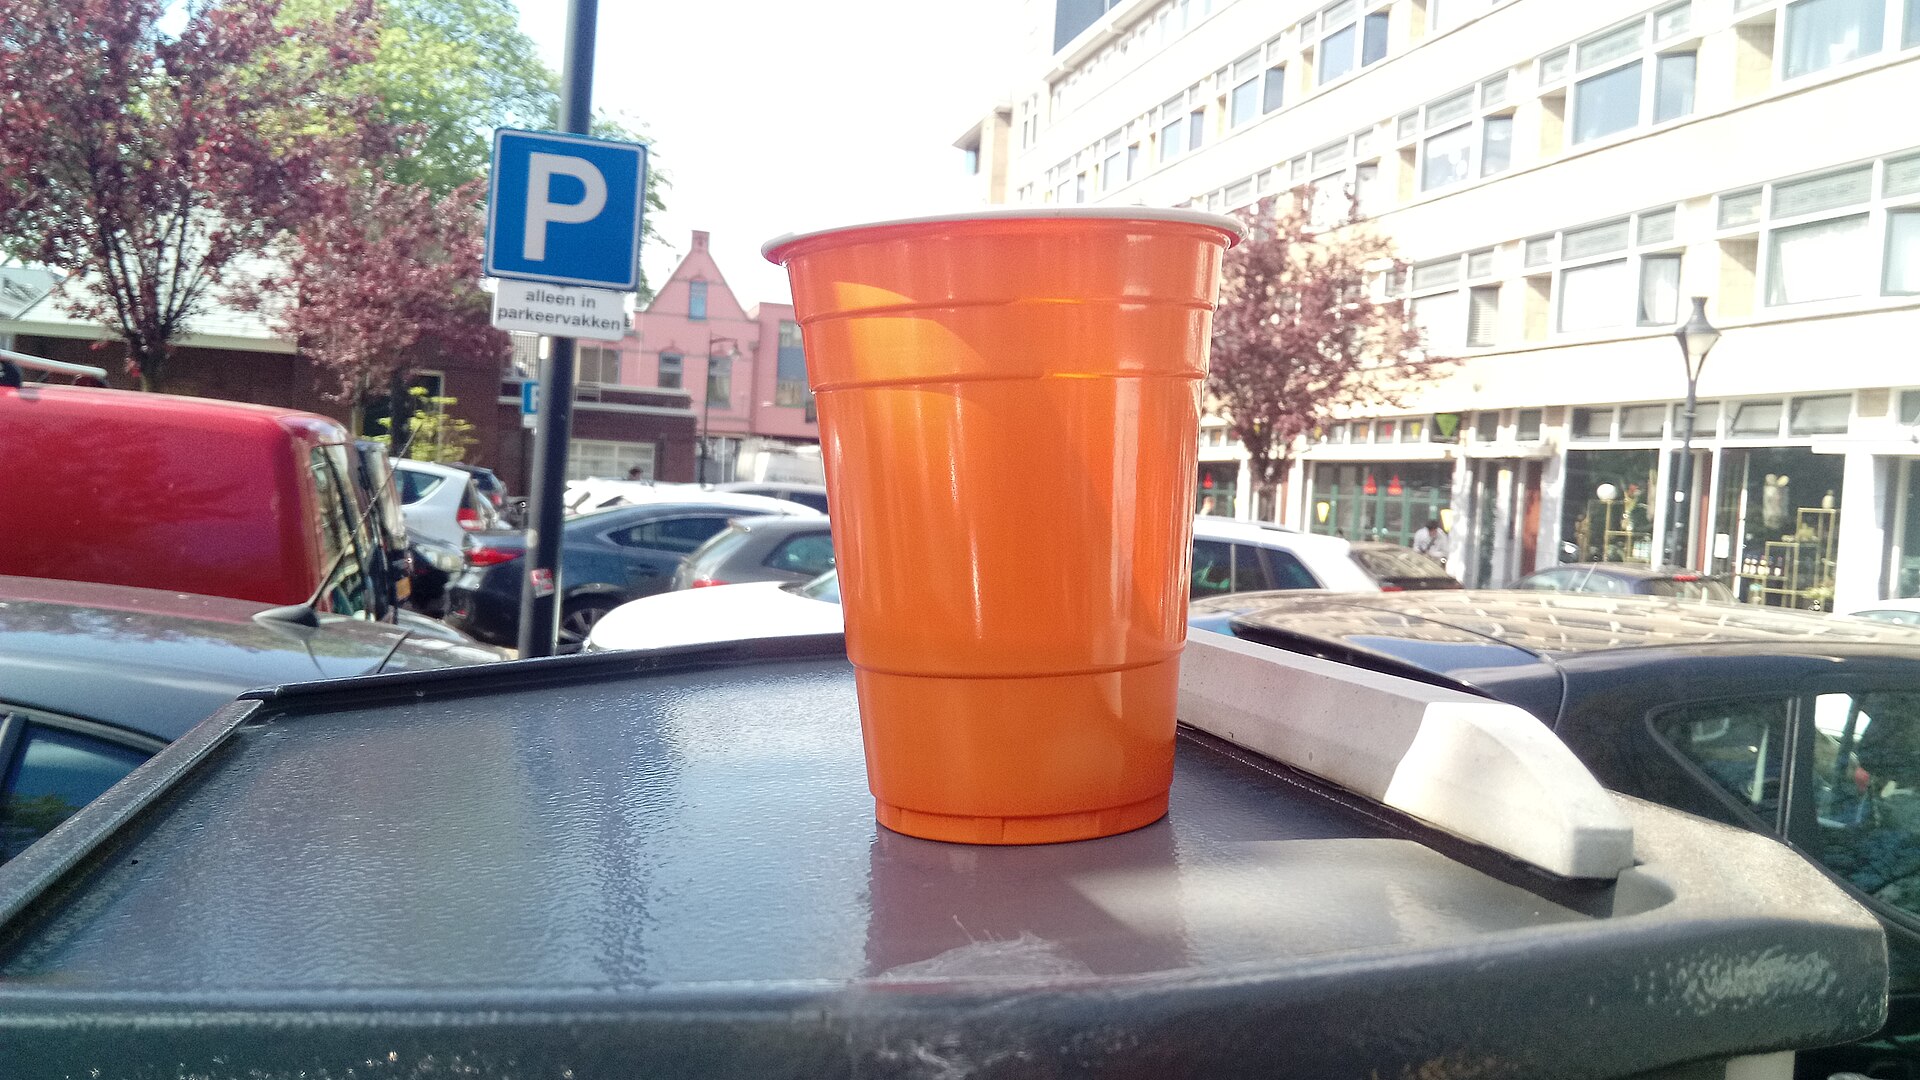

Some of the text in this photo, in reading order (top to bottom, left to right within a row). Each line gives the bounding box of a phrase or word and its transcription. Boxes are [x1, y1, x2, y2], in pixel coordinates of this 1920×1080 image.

[523, 151, 608, 261] P
[526, 289, 596, 308] alleen in
[498, 307, 620, 330] parkeervakken
